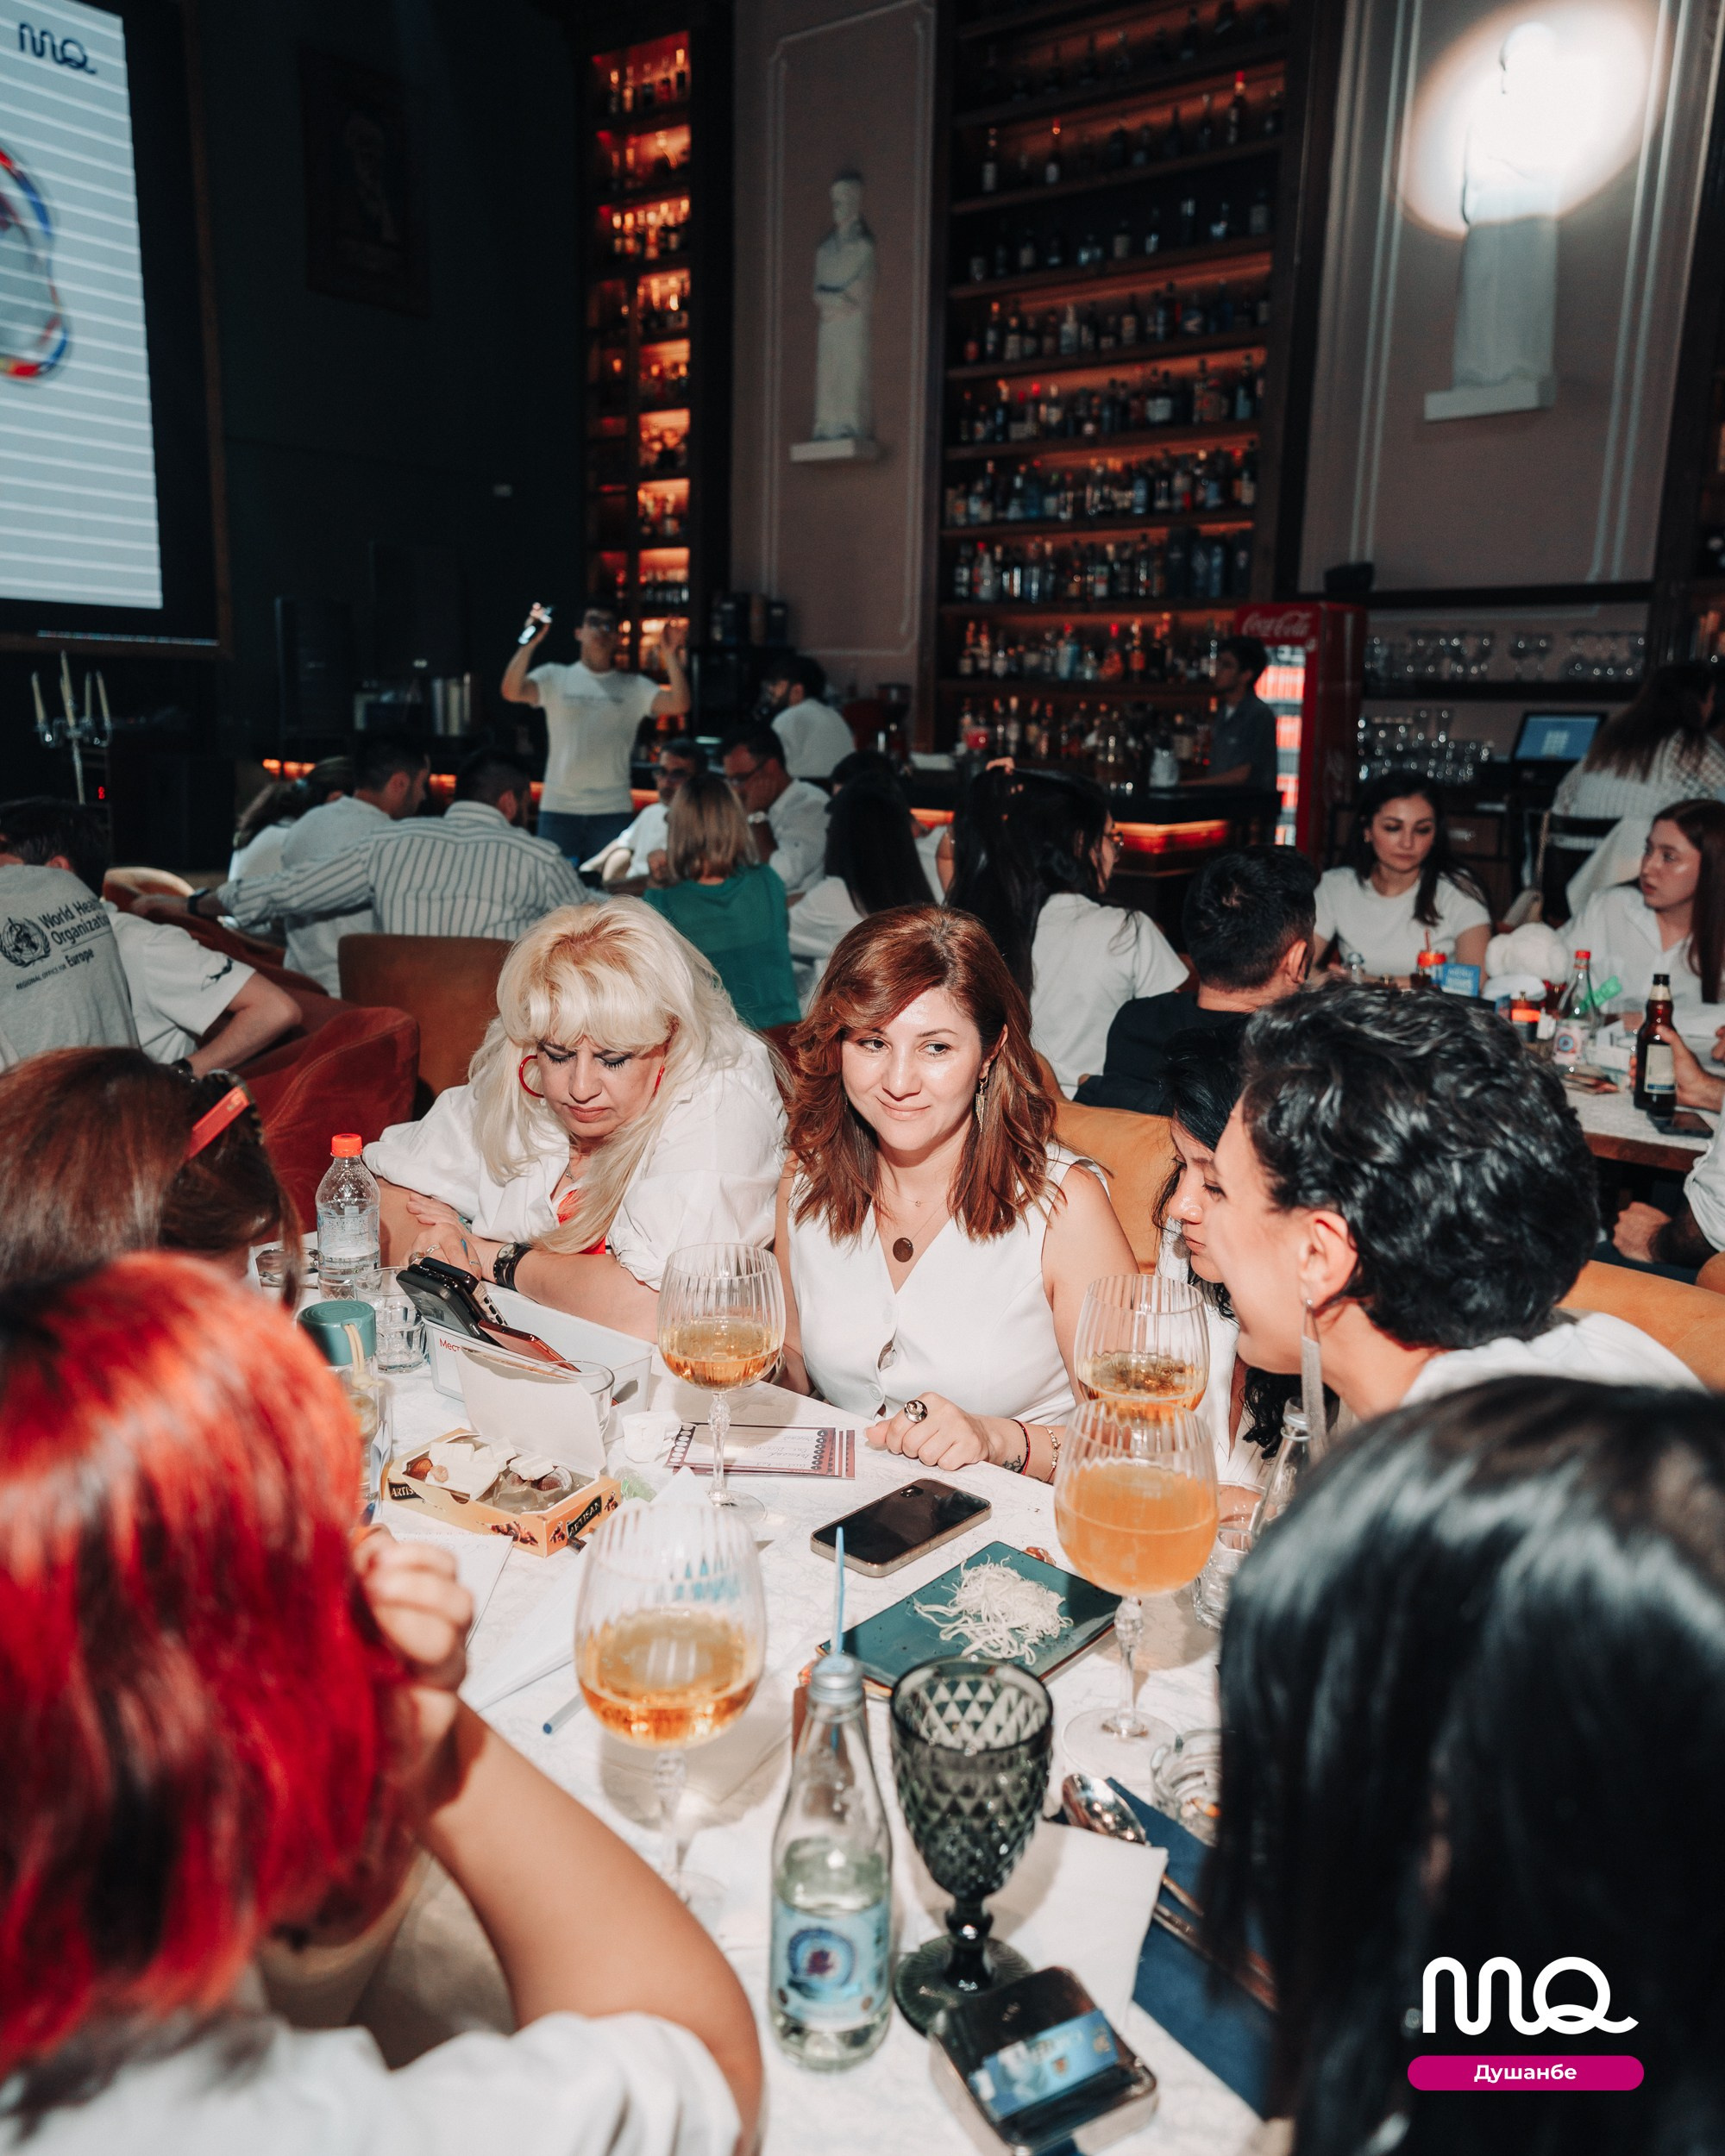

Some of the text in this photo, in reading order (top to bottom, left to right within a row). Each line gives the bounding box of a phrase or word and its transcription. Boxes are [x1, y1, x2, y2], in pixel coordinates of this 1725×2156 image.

[39, 905, 76, 929] World
[65, 948, 95, 967] Europe
[439, 1338, 461, 1352] Мест
[391, 1486, 414, 1497] ARTIS
[569, 1502, 600, 1536] ARTISAN
